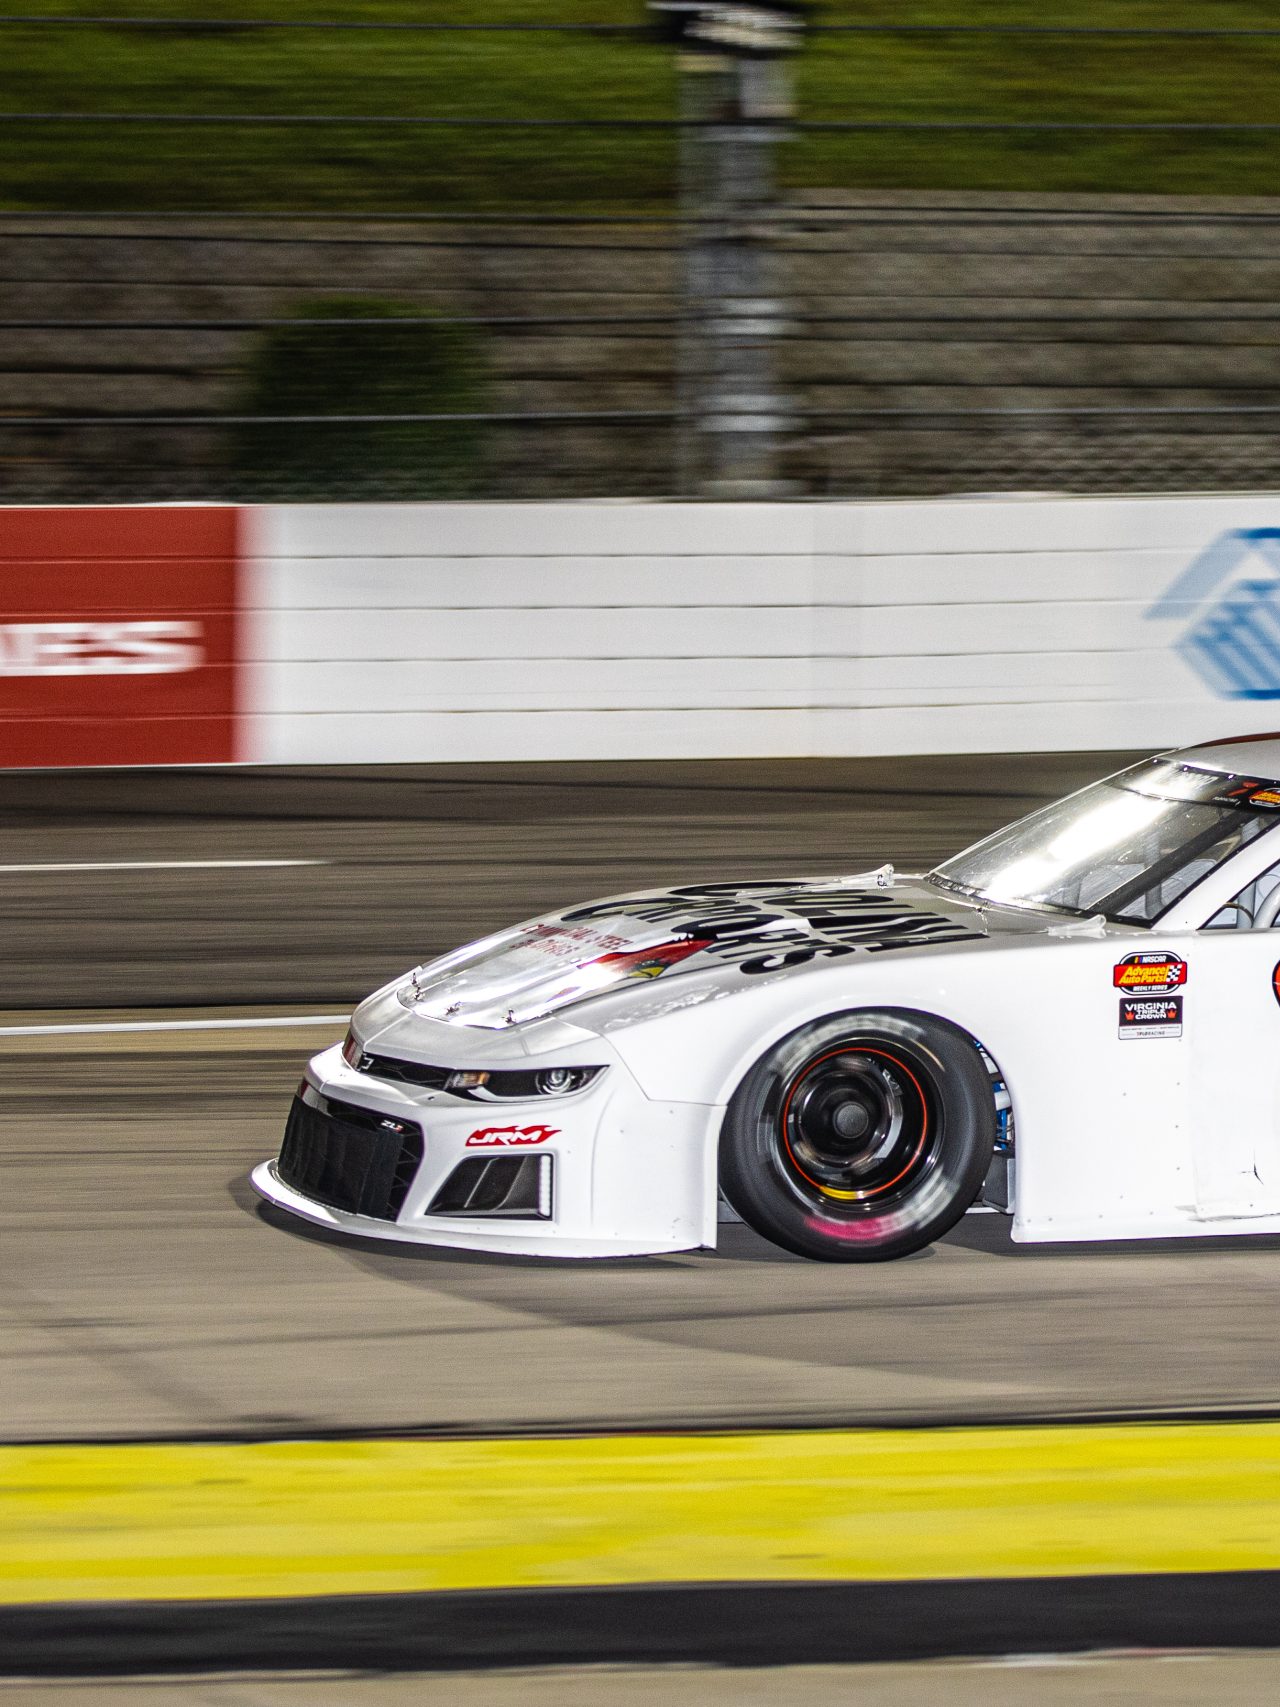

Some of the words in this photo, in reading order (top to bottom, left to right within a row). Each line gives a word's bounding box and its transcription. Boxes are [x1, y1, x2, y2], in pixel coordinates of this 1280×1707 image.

[1123, 965, 1166, 977] Advance
[1118, 975, 1141, 984] Auto
[1141, 974, 1163, 983] Parts
[1125, 1001, 1177, 1011] VIRGINIA
[468, 1130, 543, 1146] JRM
